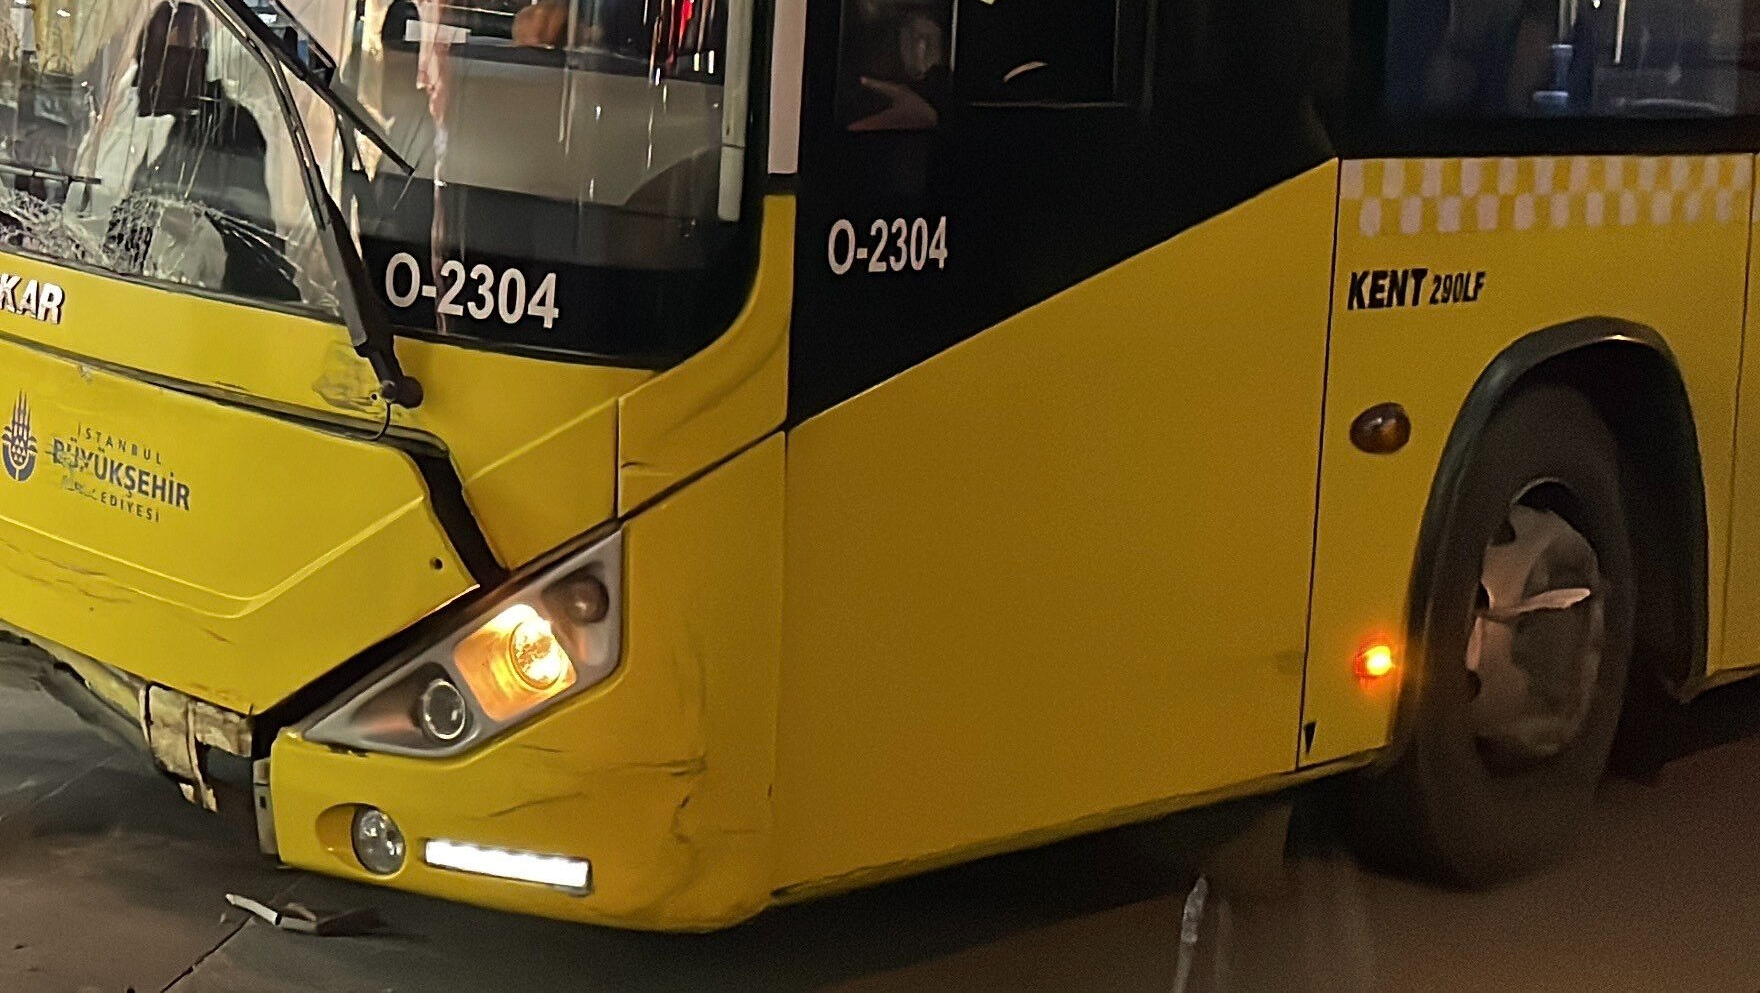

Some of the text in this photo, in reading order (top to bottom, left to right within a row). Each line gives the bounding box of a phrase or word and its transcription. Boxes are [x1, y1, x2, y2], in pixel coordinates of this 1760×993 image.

[828, 216, 948, 275] O-2304
[385, 252, 559, 329] O-2304
[1347, 268, 1428, 310] KENT
